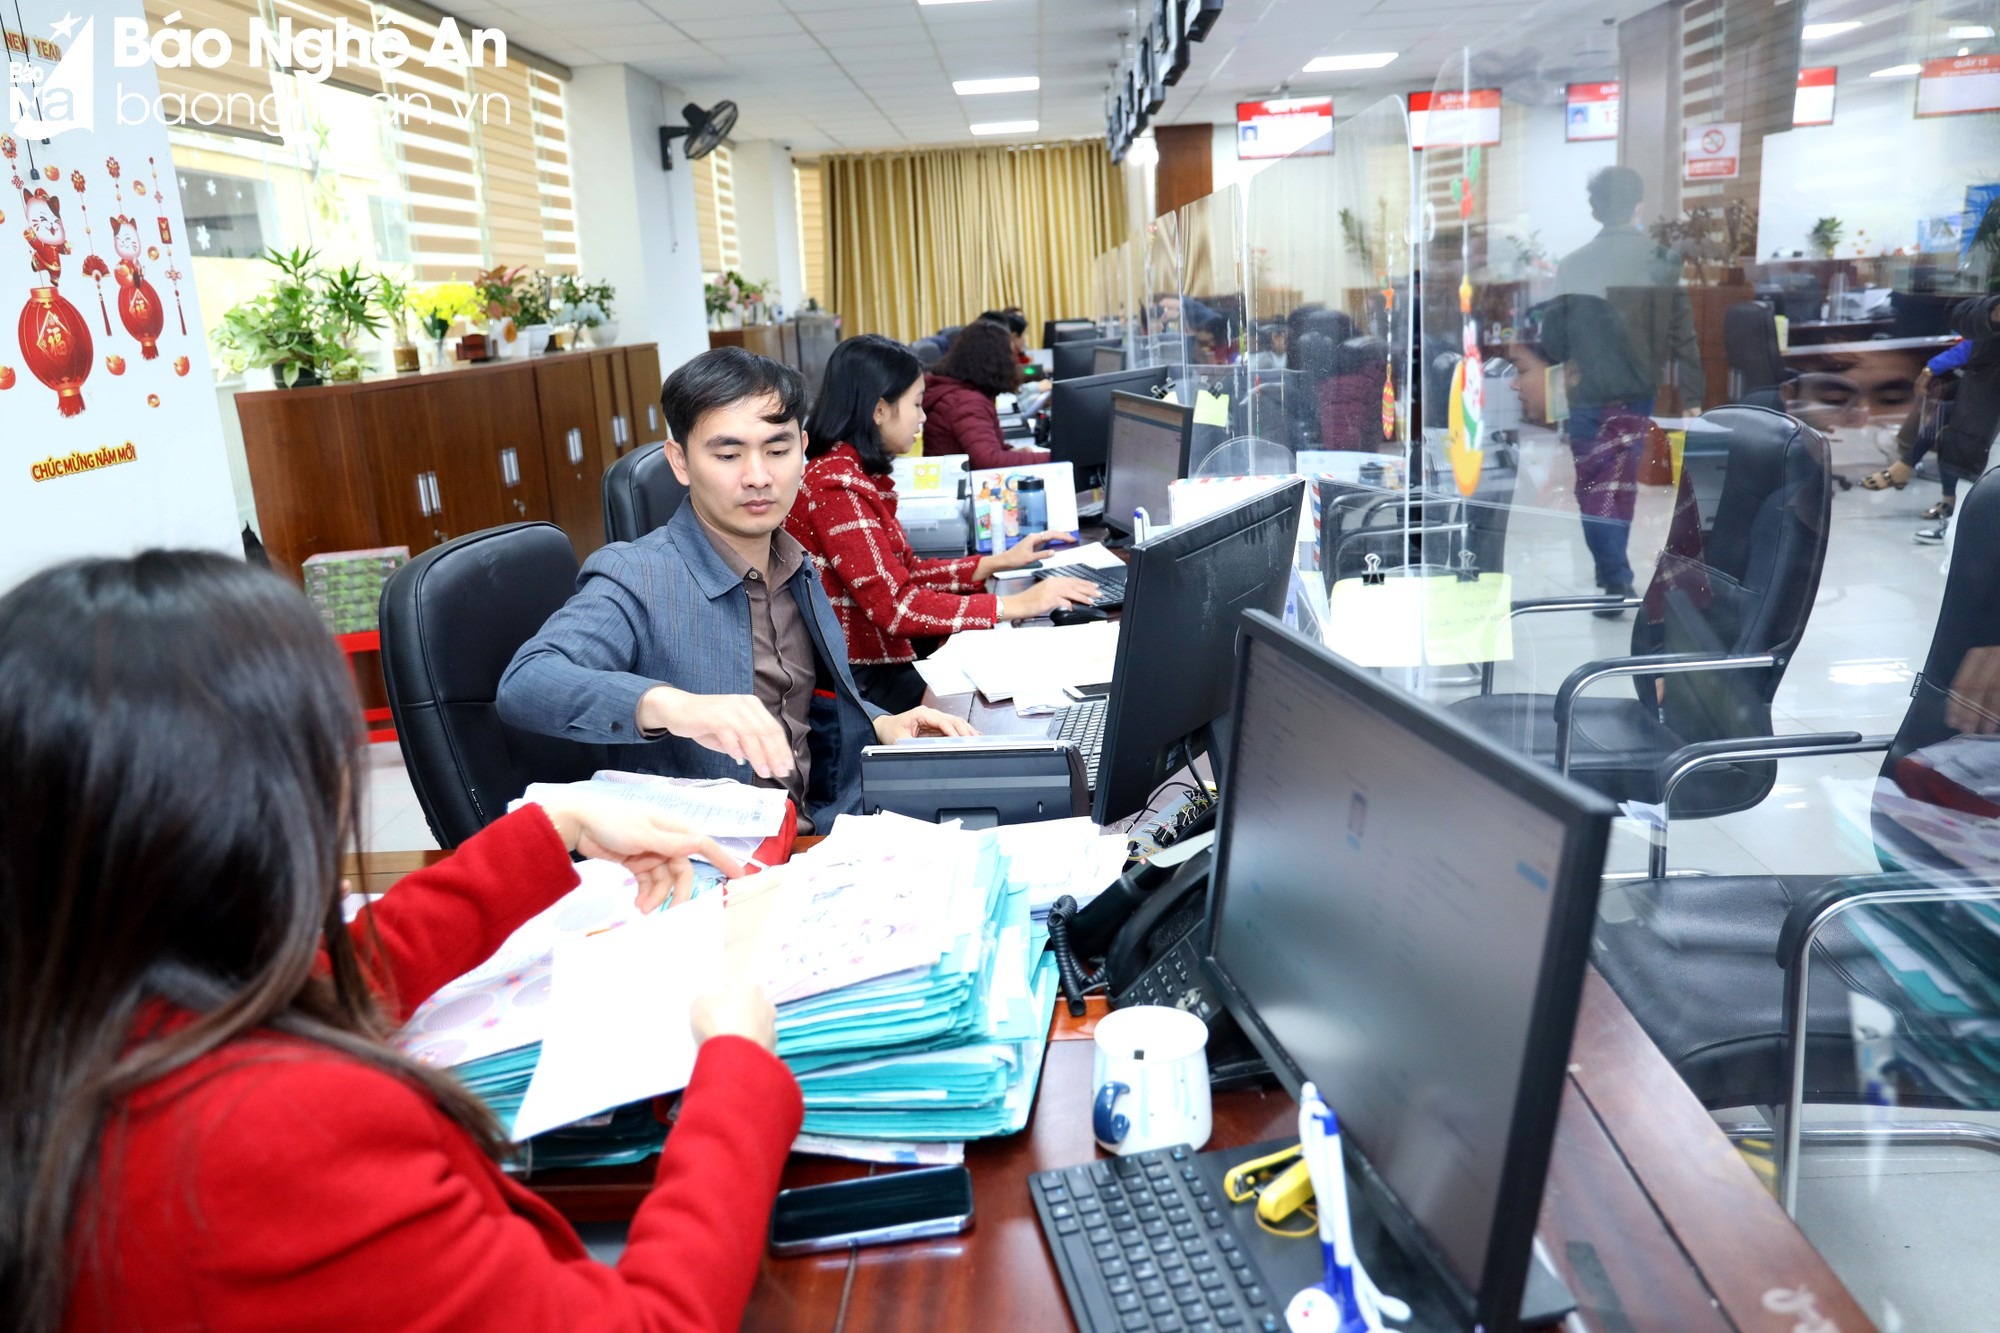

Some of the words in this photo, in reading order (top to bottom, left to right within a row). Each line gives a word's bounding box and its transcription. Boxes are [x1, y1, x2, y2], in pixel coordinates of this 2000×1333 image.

[4, 31, 29, 53] NEW
[31, 456, 64, 480] CHÚC
[63, 452, 95, 474] MỪNG
[94, 447, 117, 467] NĂM
[117, 441, 137, 462] MỚI
